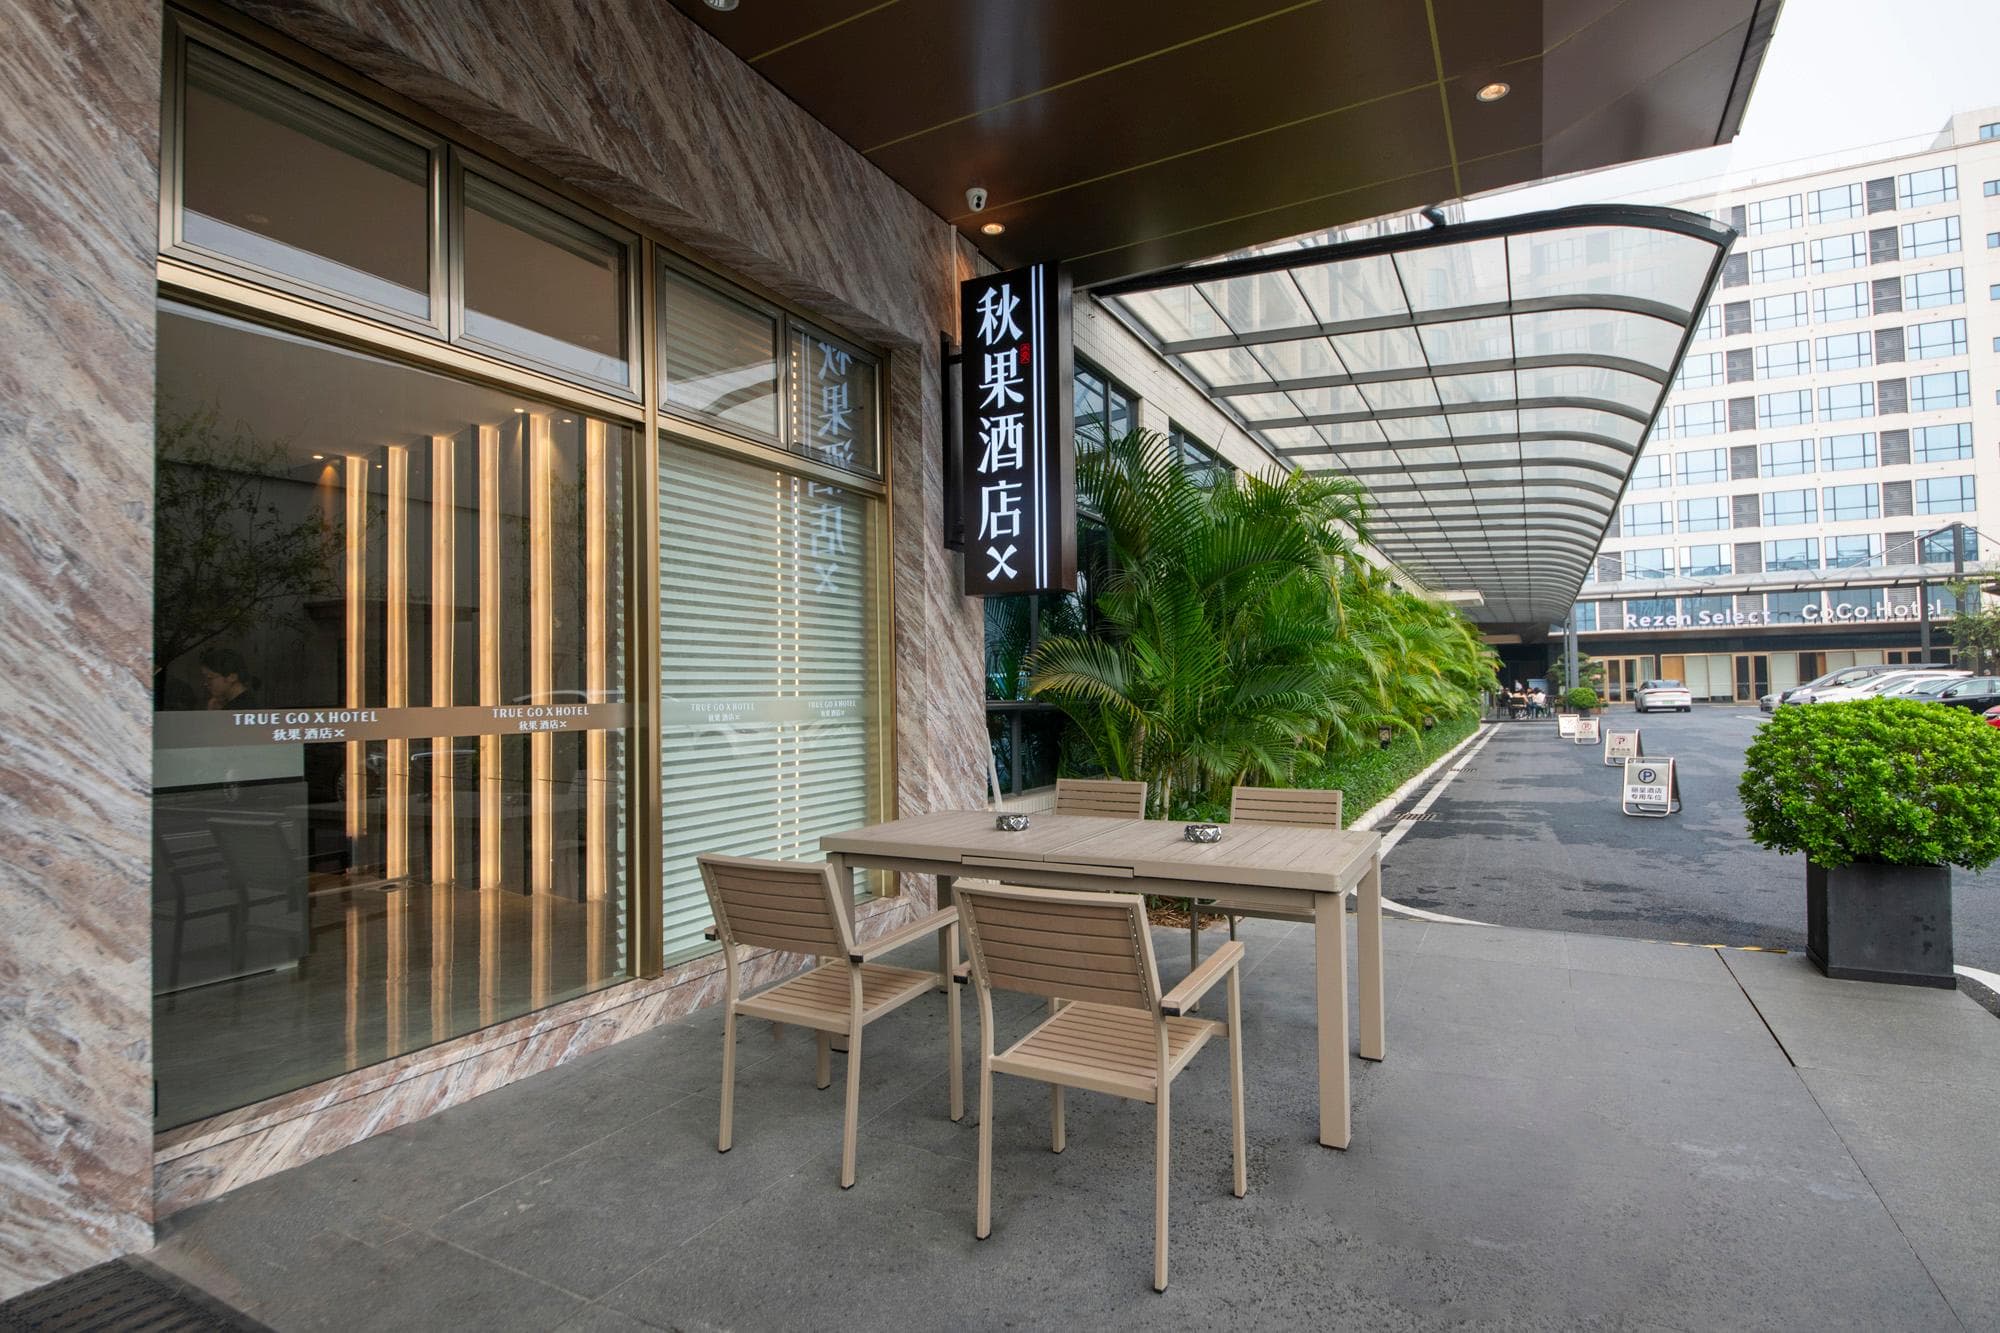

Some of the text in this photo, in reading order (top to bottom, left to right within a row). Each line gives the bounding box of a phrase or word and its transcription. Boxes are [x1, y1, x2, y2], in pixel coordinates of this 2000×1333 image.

[1802, 599, 1941, 620] CoCo Hotel
[1625, 609, 1771, 628] Rezen Select
[233, 711, 378, 726] TRUE GO X HOTEL
[492, 706, 590, 718] TRUE GO X HOTEL
